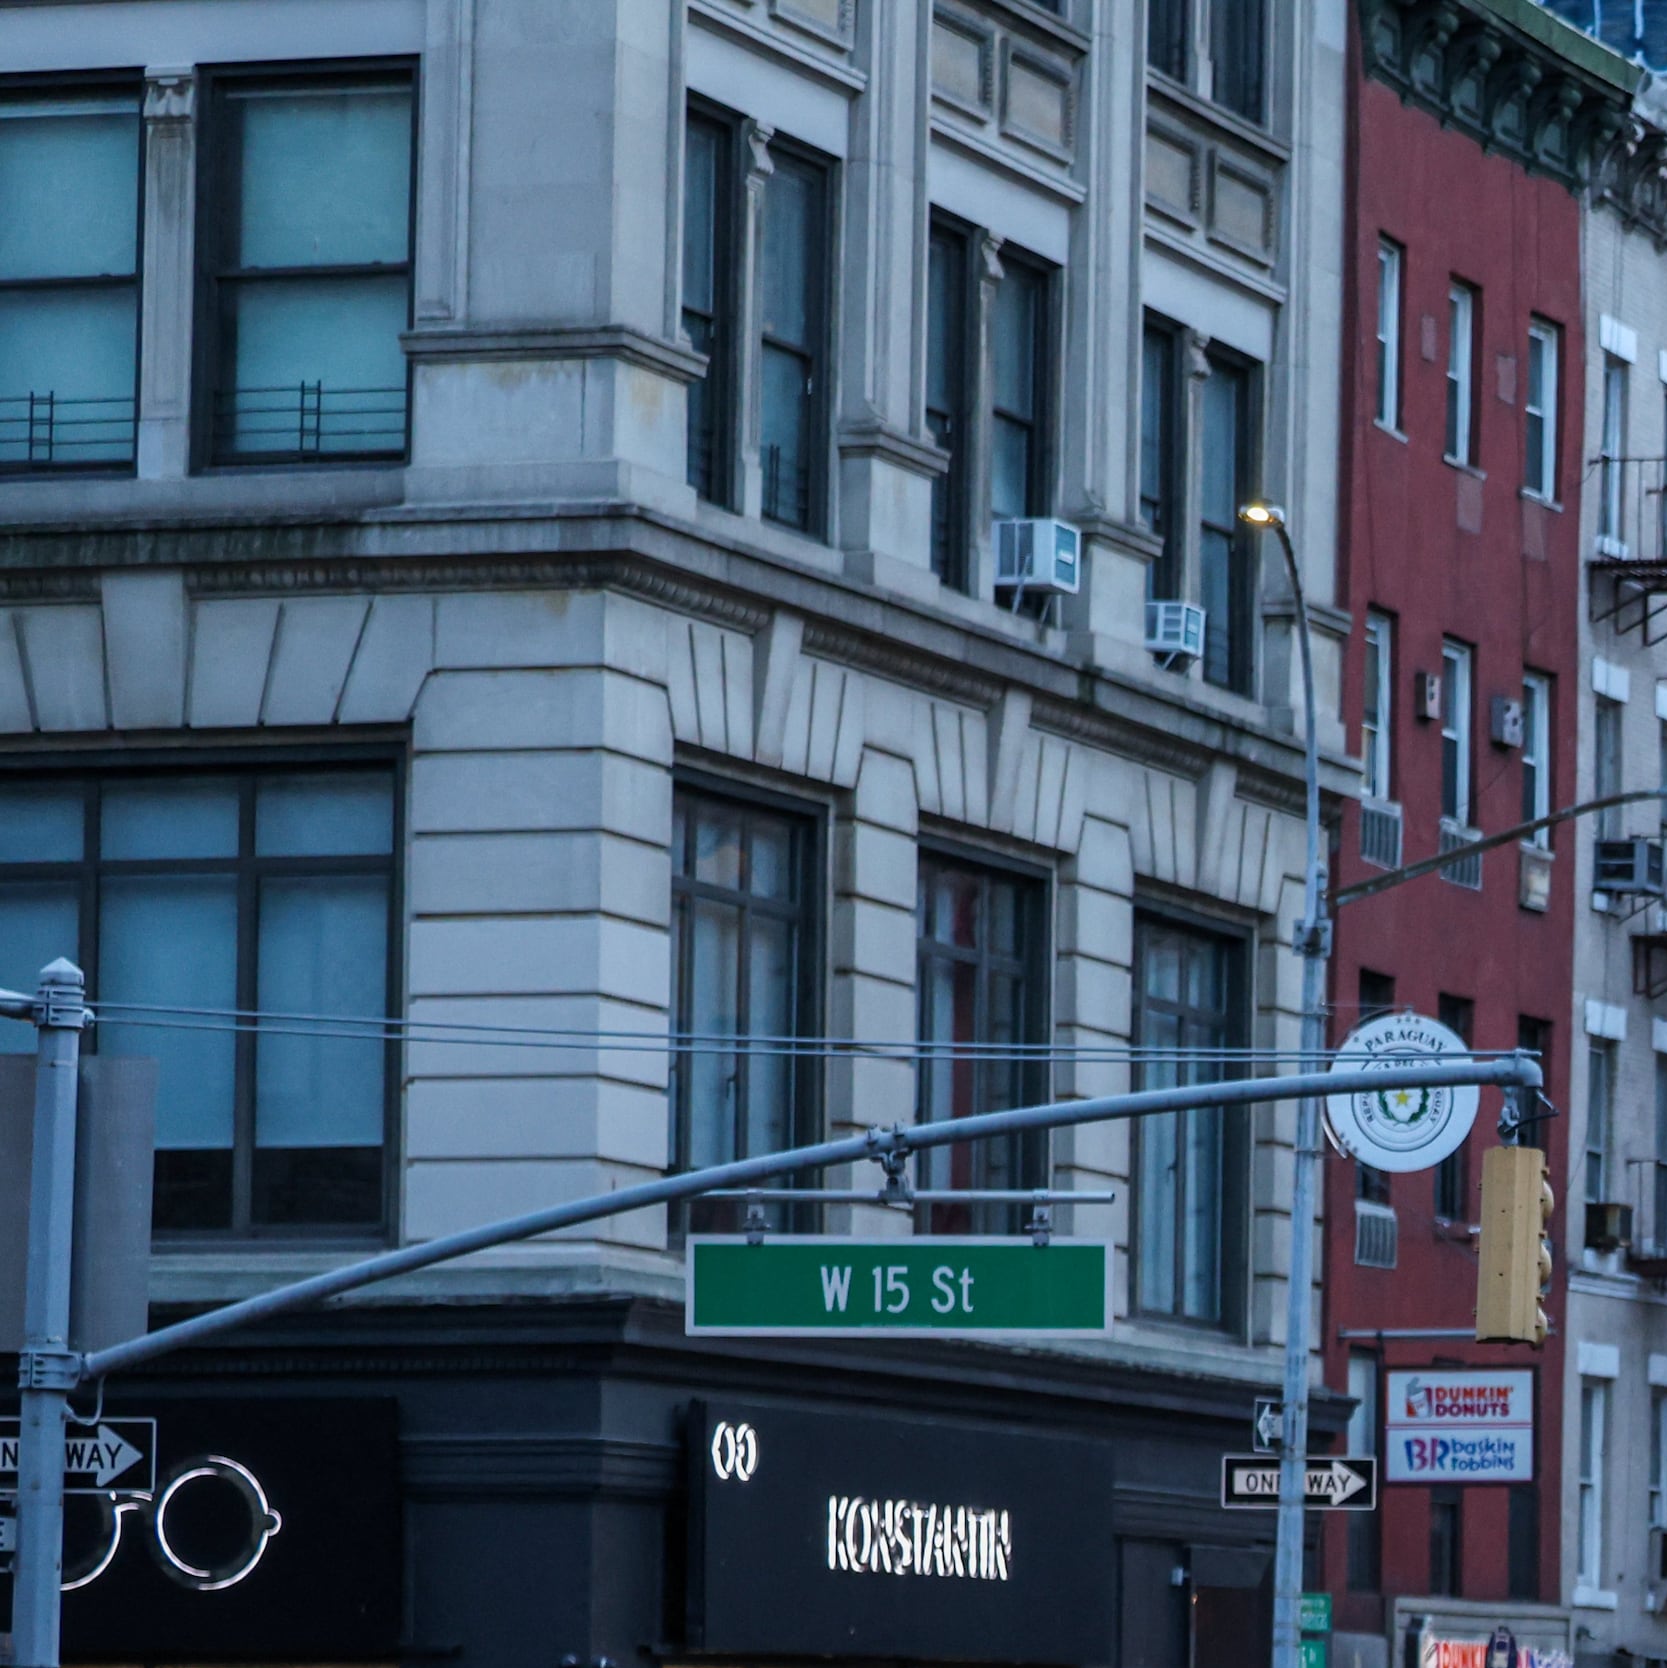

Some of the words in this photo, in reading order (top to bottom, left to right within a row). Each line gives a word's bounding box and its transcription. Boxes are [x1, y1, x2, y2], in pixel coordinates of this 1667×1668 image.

[1365, 1030, 1446, 1053] PARAGUAY
[820, 1266, 852, 1313] W
[872, 1266, 909, 1313] 15
[931, 1266, 974, 1314] St
[1435, 1386, 1514, 1402] DUNKIN'
[1435, 1401, 1511, 1418] DONUTS
[65, 1442, 123, 1470] WAY
[1405, 1438, 1447, 1472] BR
[1450, 1438, 1516, 1455] baskin
[1450, 1453, 1516, 1472] robbins
[828, 1496, 1012, 1581] KONSTANTIN
